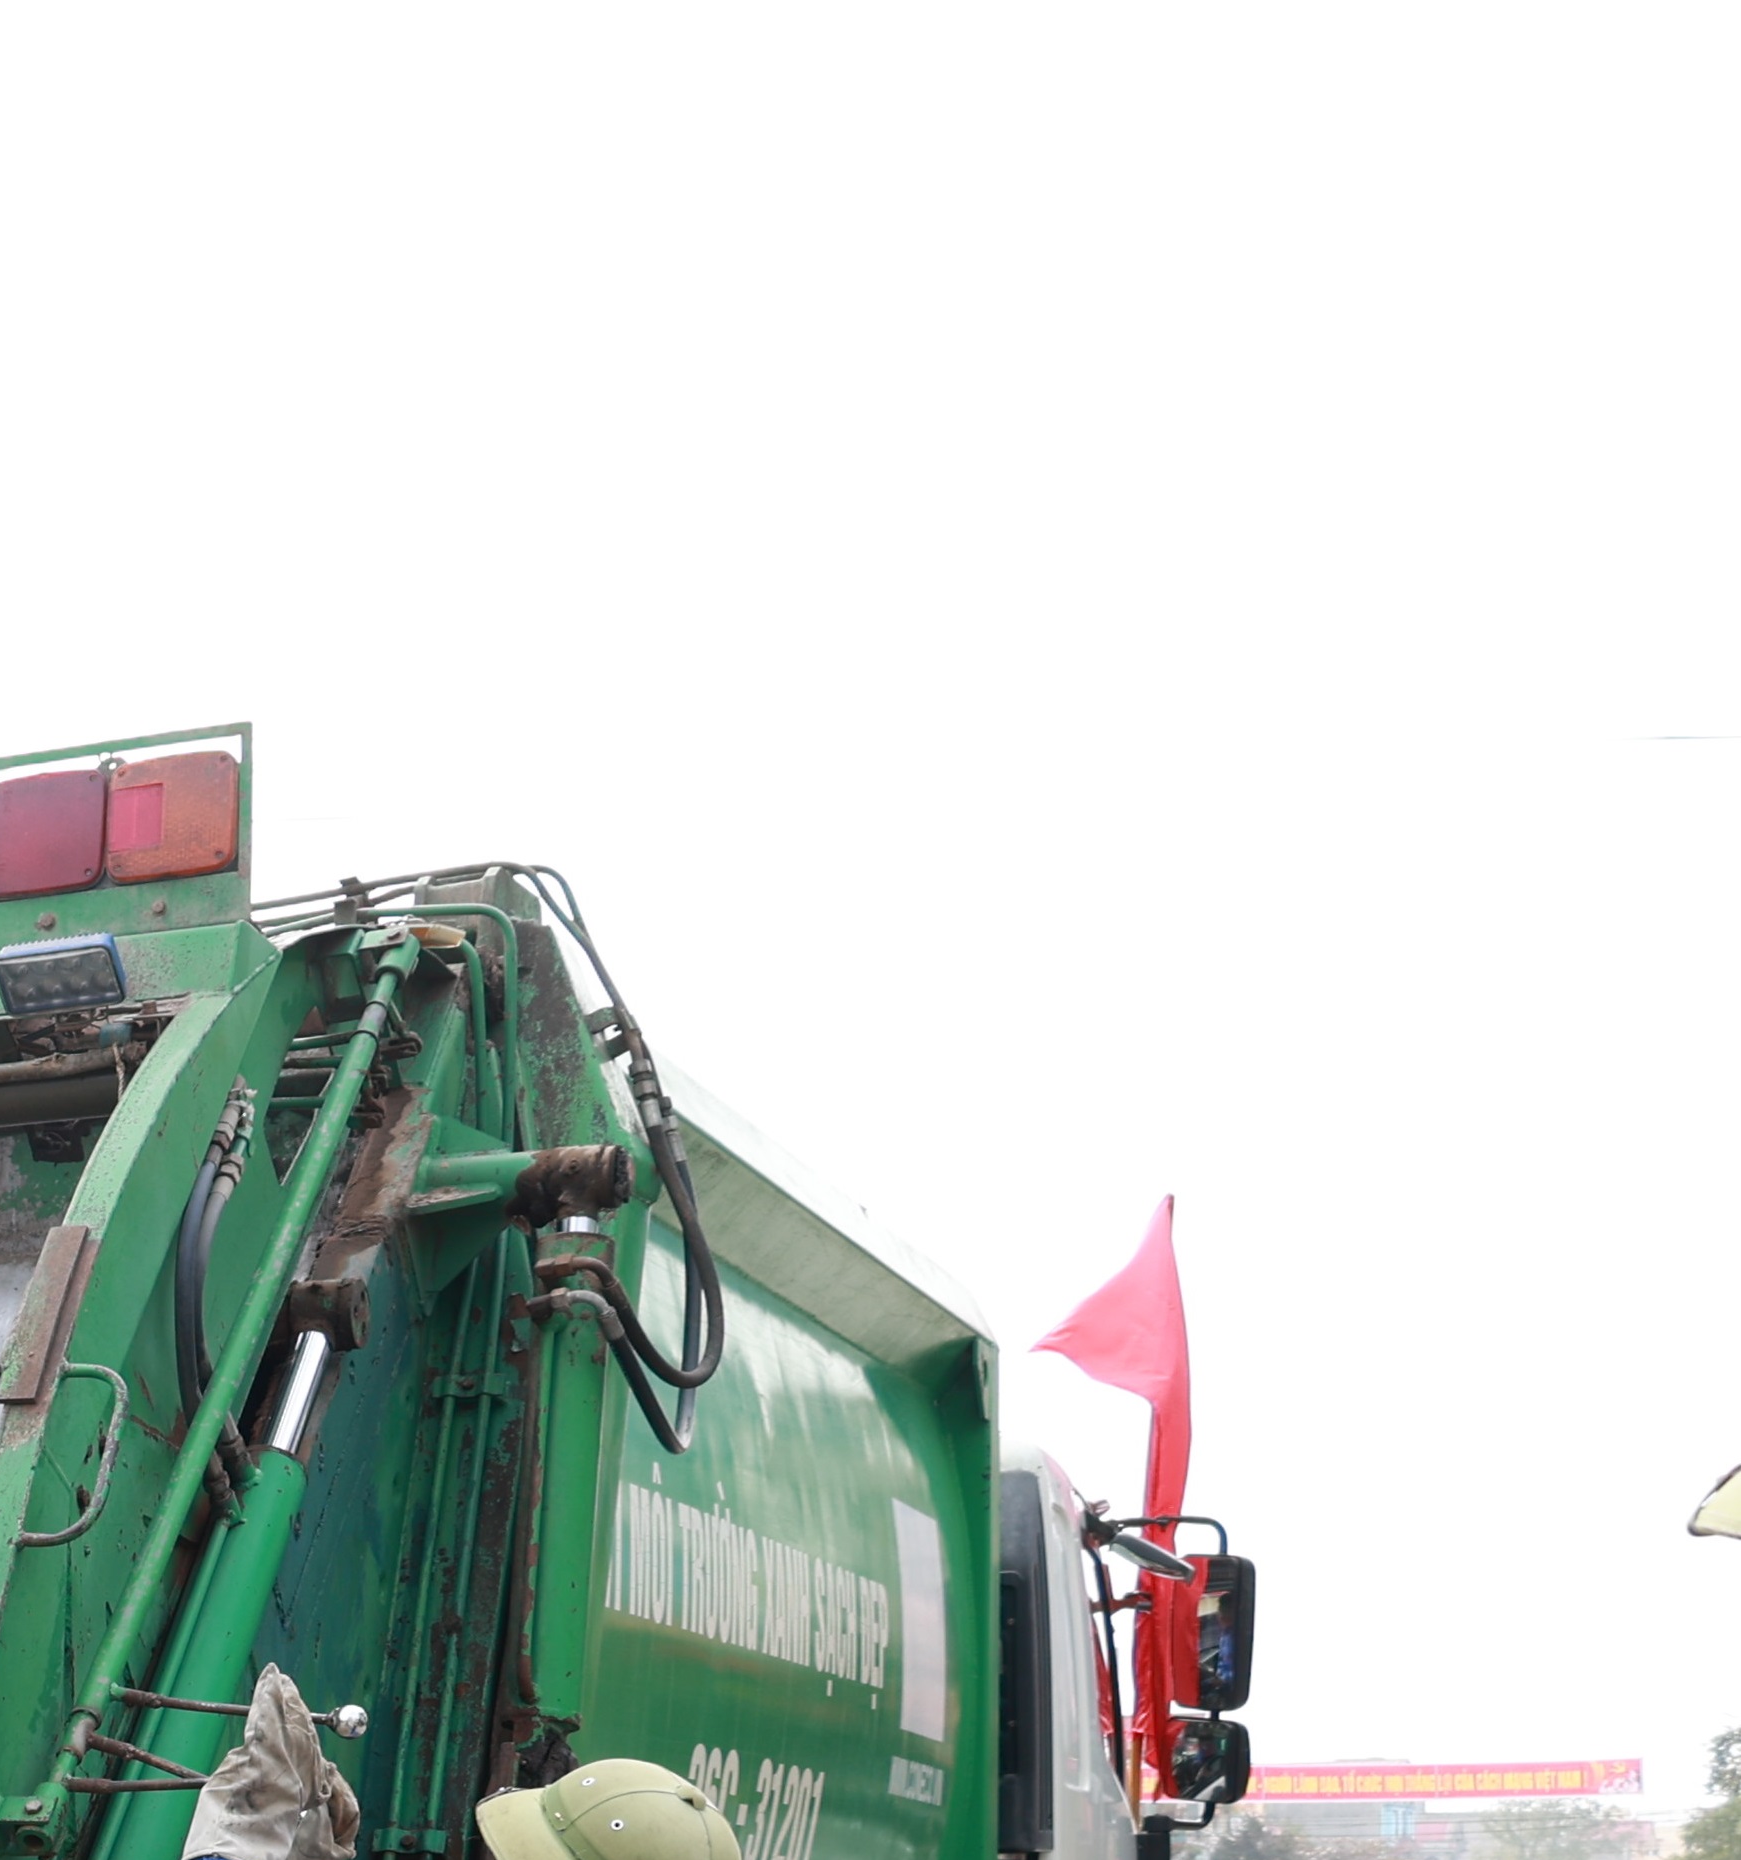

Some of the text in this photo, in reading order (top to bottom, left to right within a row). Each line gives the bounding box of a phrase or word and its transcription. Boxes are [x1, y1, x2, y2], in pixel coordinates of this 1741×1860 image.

[628, 1461, 673, 1627] MÔI
[677, 1481, 758, 1652] TRƯỜNG
[761, 1535, 810, 1668] XANH
[814, 1556, 856, 1697] SẠCH
